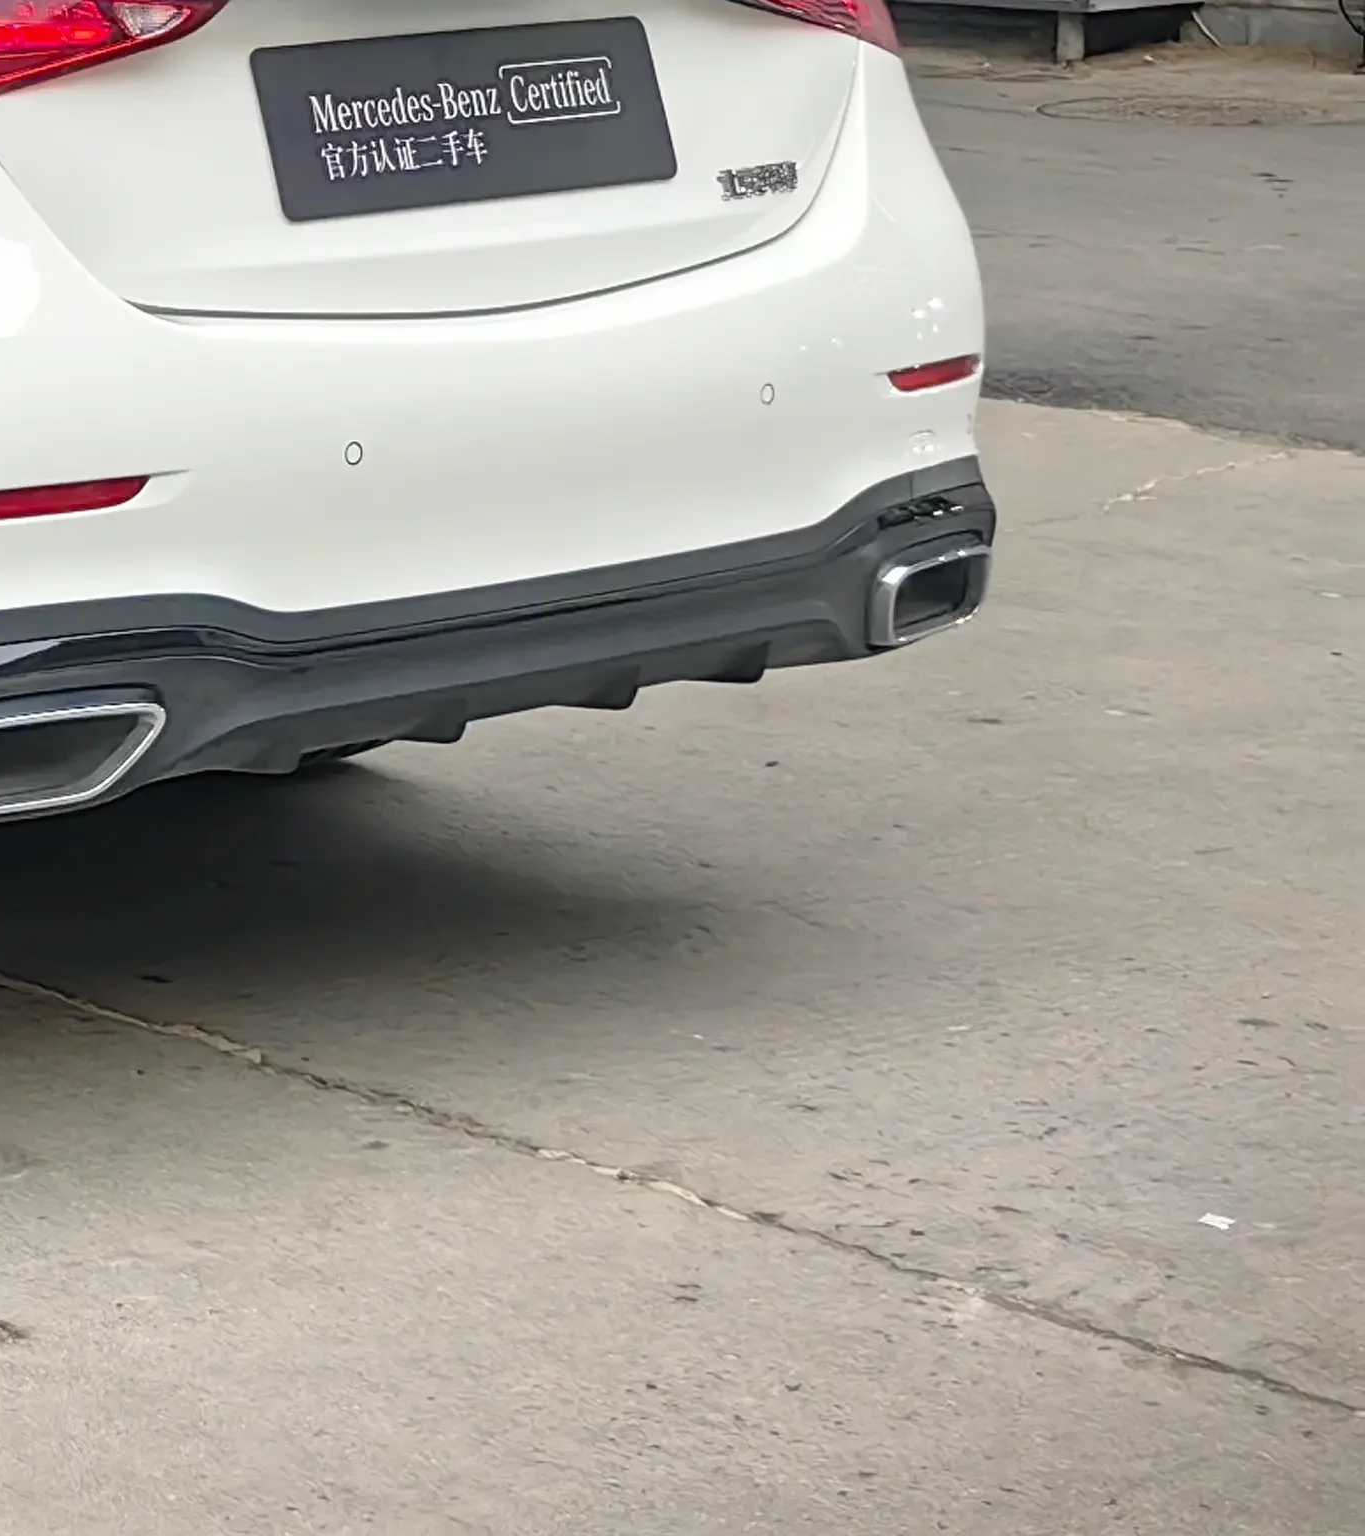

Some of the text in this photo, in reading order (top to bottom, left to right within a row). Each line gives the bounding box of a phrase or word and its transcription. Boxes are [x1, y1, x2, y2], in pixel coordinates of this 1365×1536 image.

[308, 67, 612, 135] Mercedes-Benz Certified
[320, 128, 488, 181] 官方认证二手车
